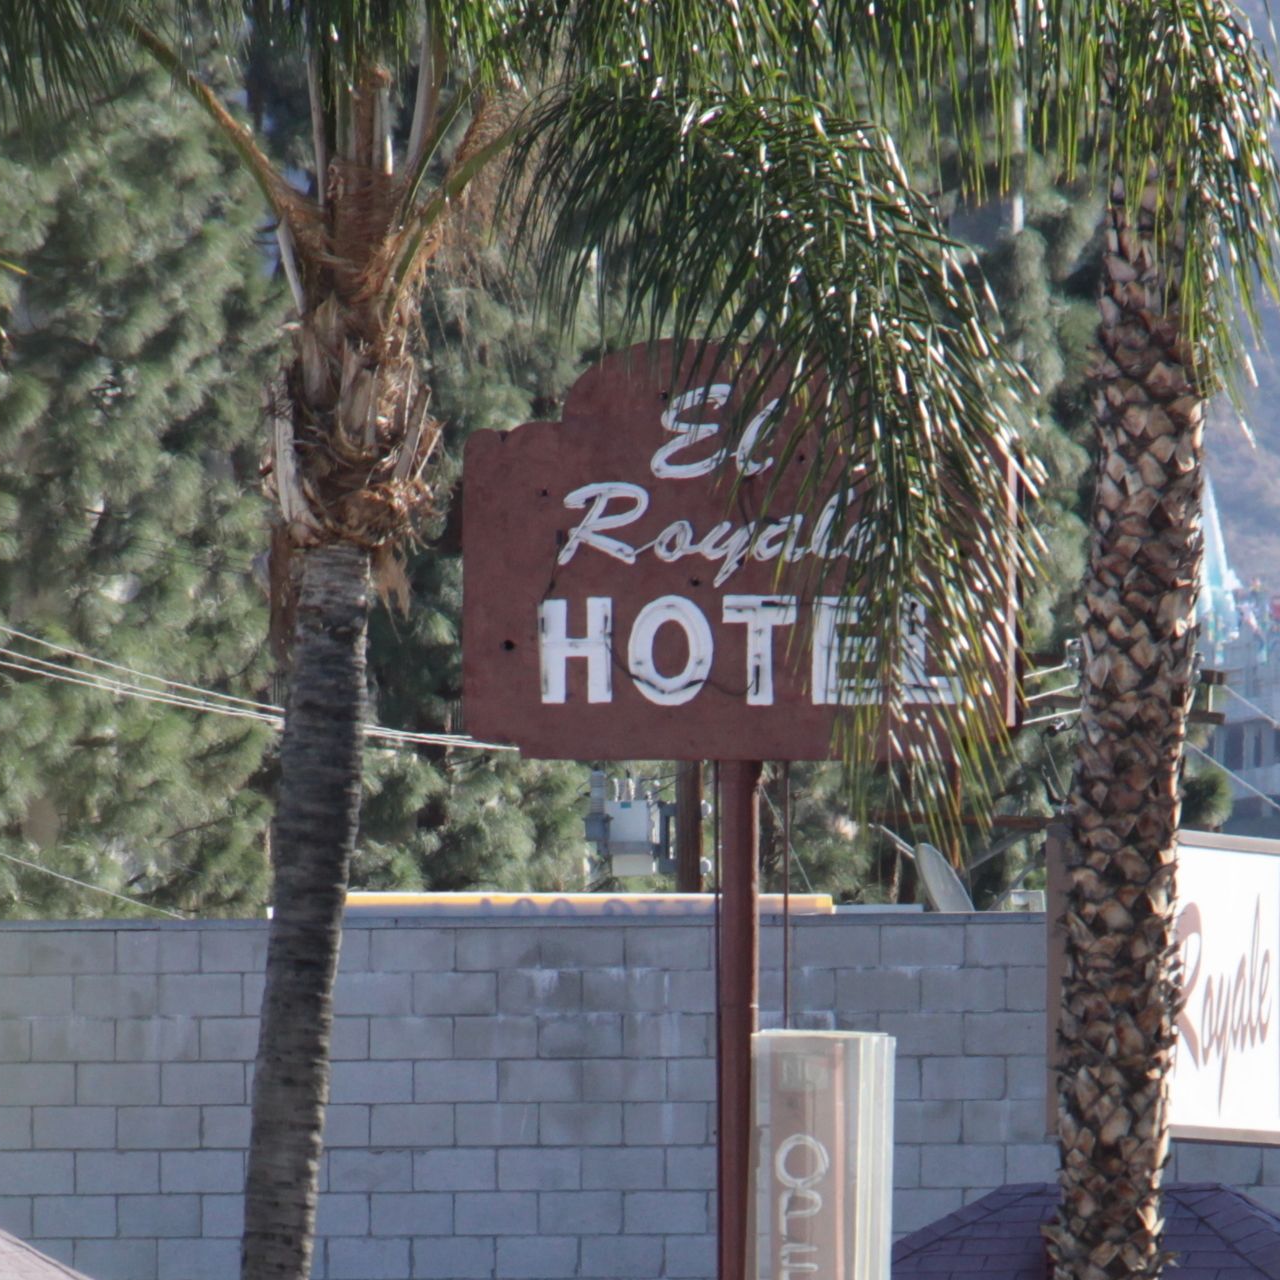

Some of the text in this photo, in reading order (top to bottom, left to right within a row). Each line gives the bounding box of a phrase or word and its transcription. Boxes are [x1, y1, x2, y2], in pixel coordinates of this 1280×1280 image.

[650, 383, 780, 479] El
[538, 594, 964, 706] HOTEL
[1172, 893, 1272, 1118] Royale
